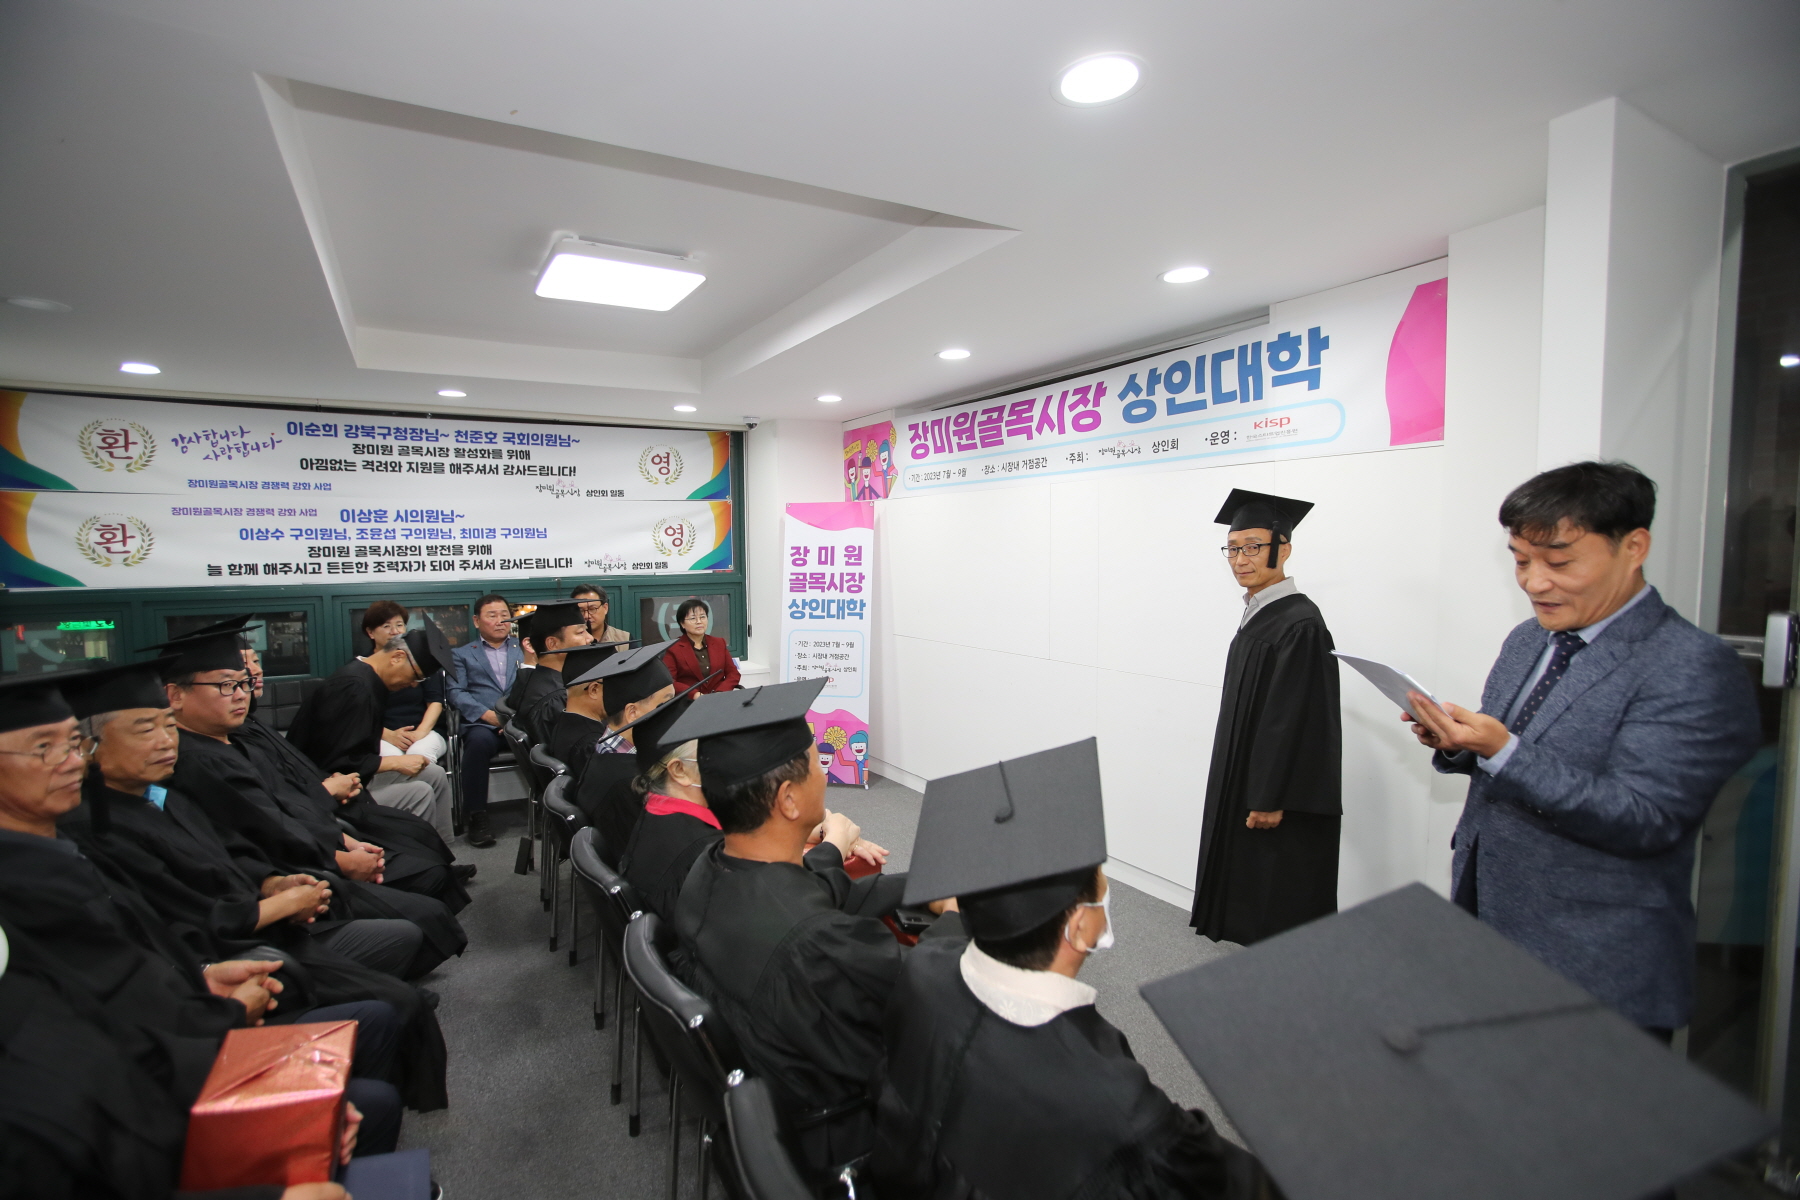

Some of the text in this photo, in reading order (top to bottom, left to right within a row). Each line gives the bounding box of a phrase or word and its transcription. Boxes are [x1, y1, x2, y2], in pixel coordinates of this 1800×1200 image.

[908, 326, 1330, 460] 장미원골목시장 상인대학
[96, 427, 138, 461] 환
[171, 425, 251, 454] 감사합니다
[287, 421, 580, 448] 이순희 강북구청장님~ 천준호 국회의원님~
[202, 437, 283, 461] 사랑합니다
[352, 443, 531, 461] 장미원 골목시장 활성화를 위해
[942, 469, 952, 479] 7월
[957, 467, 967, 478] 9월
[1001, 460, 1019, 473] 시장내
[1021, 456, 1048, 470] 거점공간
[1151, 438, 1179, 454] 상인회
[300, 457, 577, 477] 아낌없는 격려와 지원을 해주셔서 감사드립니다!
[651, 451, 671, 476] 영
[187, 479, 332, 491] 장미원골목시장 경쟁력 강화 사업
[585, 489, 609, 498] 상인회
[610, 489, 625, 498] 일동
[171, 506, 318, 517] 장미원골목시장 경쟁력 강화 사업
[340, 508, 465, 523] 이상훈 시의원님~
[93, 522, 136, 556] 환
[239, 527, 548, 541] 이상수 구의원님, 조윤섭 구의원님, 최미경 구의원님
[664, 523, 684, 548] 영
[308, 544, 492, 558] 장미원 골목시장의 발전을 위해
[206, 557, 573, 577] 늘 함께 해주시고 든든한 조력자가 되어 주셔서 감사드립니다!
[632, 561, 653, 570] 상인회
[654, 561, 669, 570] 일동
[789, 571, 865, 593] 골목시장
[788, 598, 866, 620] 상인대학
